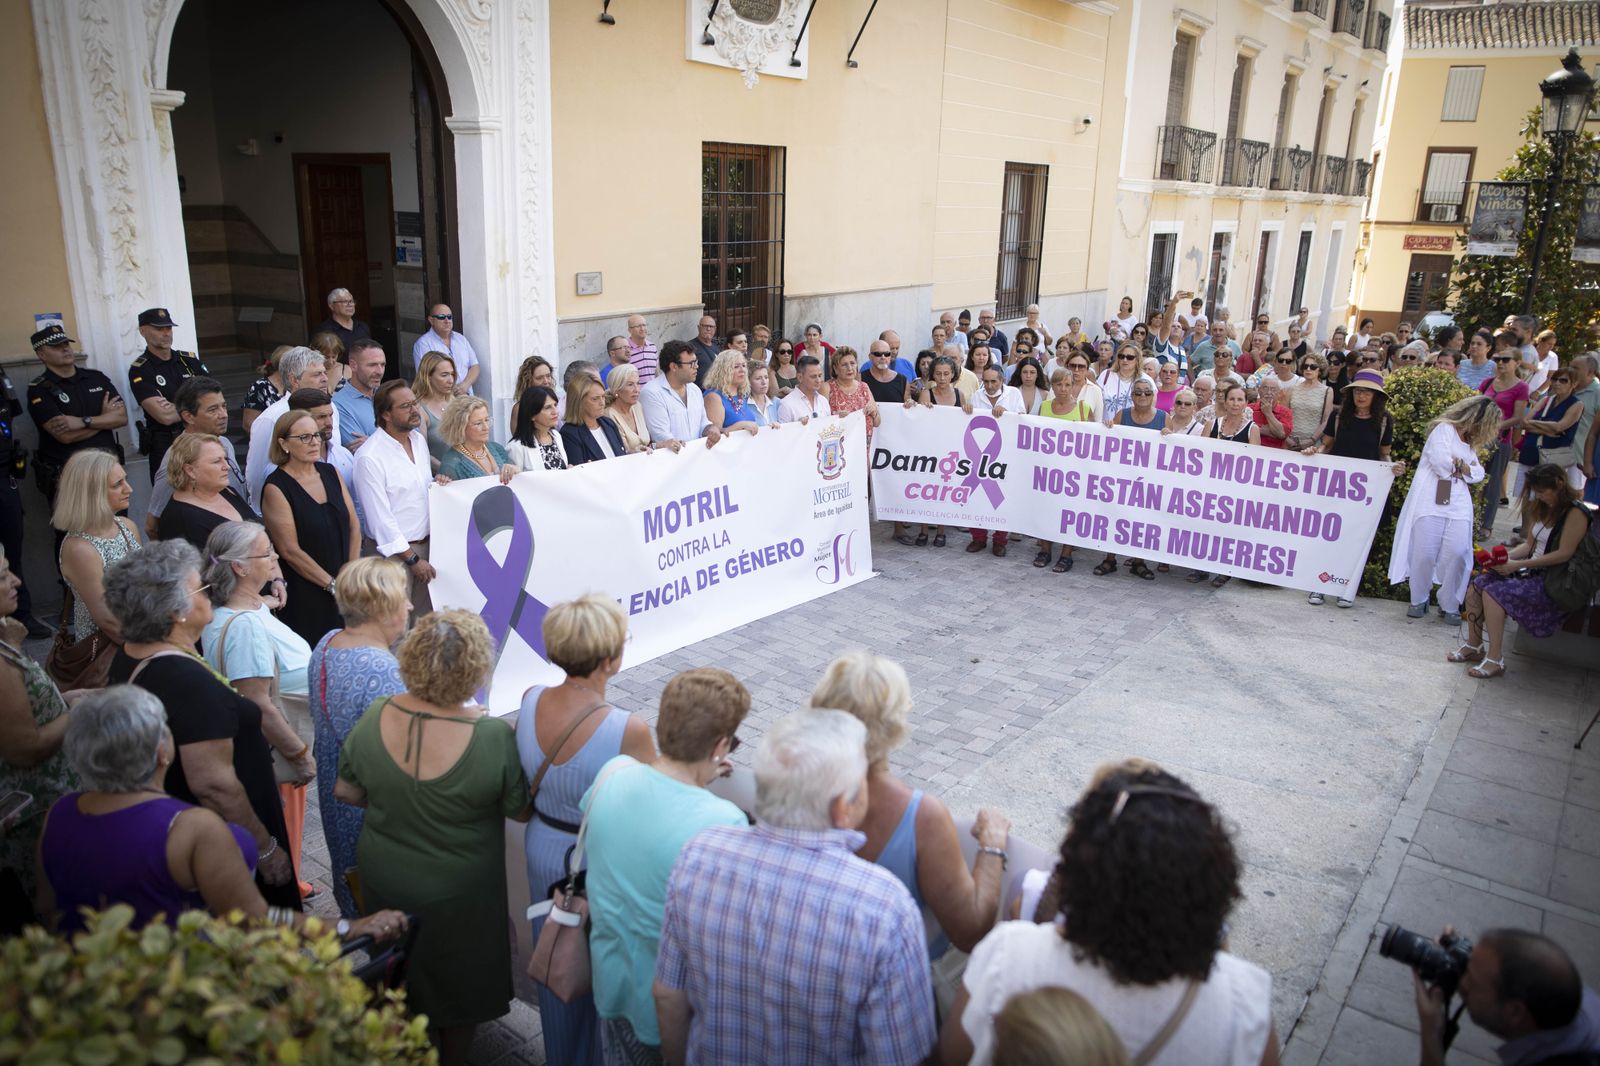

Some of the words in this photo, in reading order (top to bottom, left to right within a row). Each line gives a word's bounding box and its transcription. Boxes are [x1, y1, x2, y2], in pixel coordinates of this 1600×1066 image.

[978, 455, 1008, 480] la
[1016, 423, 1151, 468] DISCULPEN
[1156, 443, 1204, 476] LAS
[1209, 451, 1373, 506] MOLESTIAS,
[643, 485, 739, 544] MOTRIL
[813, 481, 852, 506] MOTRIL
[904, 482, 970, 504] cara
[918, 510, 960, 519] VIOLENCIA
[1032, 465, 1080, 498] NOS
[1086, 473, 1163, 511] ESTÁN
[1166, 487, 1343, 542] ASESINANDO
[658, 535, 710, 571] CONTRA
[713, 529, 731, 549] LA
[1060, 509, 1109, 542] POR
[1114, 518, 1162, 551] SER
[1166, 527, 1298, 577] MUJERES!
[617, 575, 691, 616] ENCIA
[696, 563, 720, 591] DE
[725, 537, 805, 579] GÉNERO
